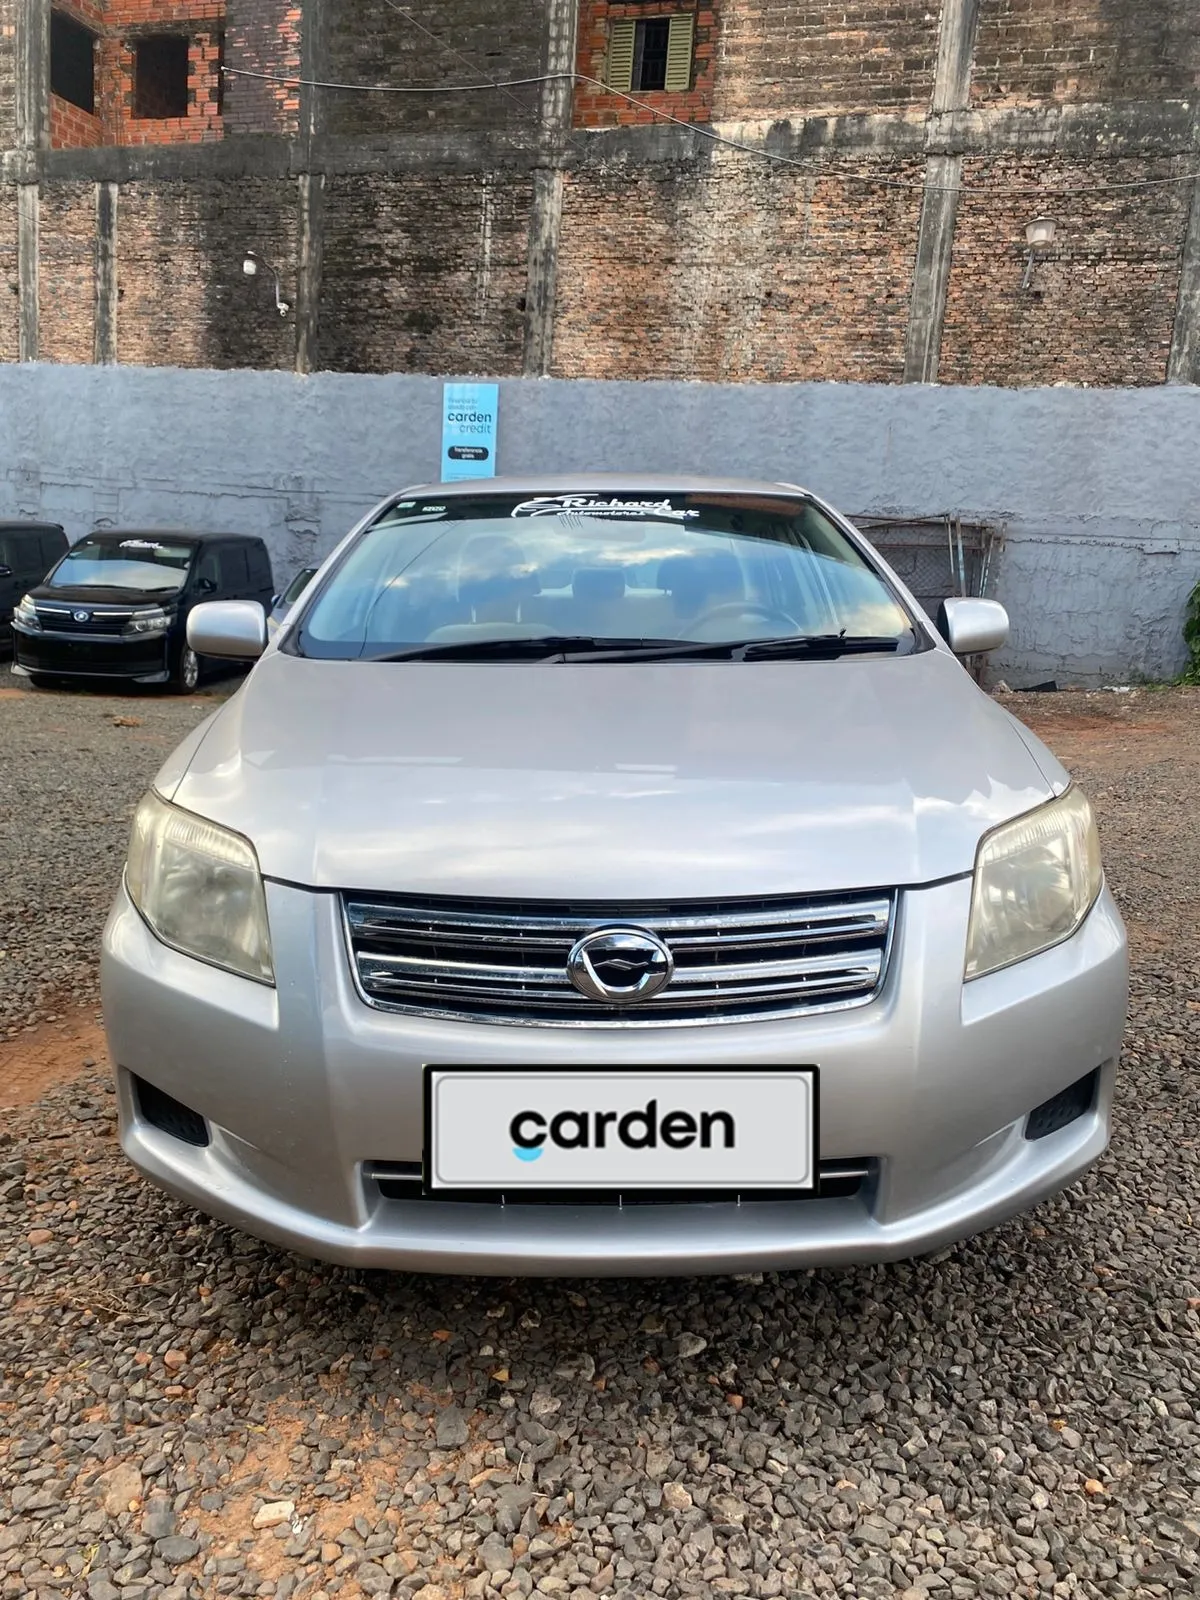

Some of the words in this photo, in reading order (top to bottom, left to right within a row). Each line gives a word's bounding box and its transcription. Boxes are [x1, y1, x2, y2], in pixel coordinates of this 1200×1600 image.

[448, 411, 492, 422] carden
[459, 424, 491, 433] credit
[556, 497, 670, 507] Richard
[653, 505, 700, 520] Car
